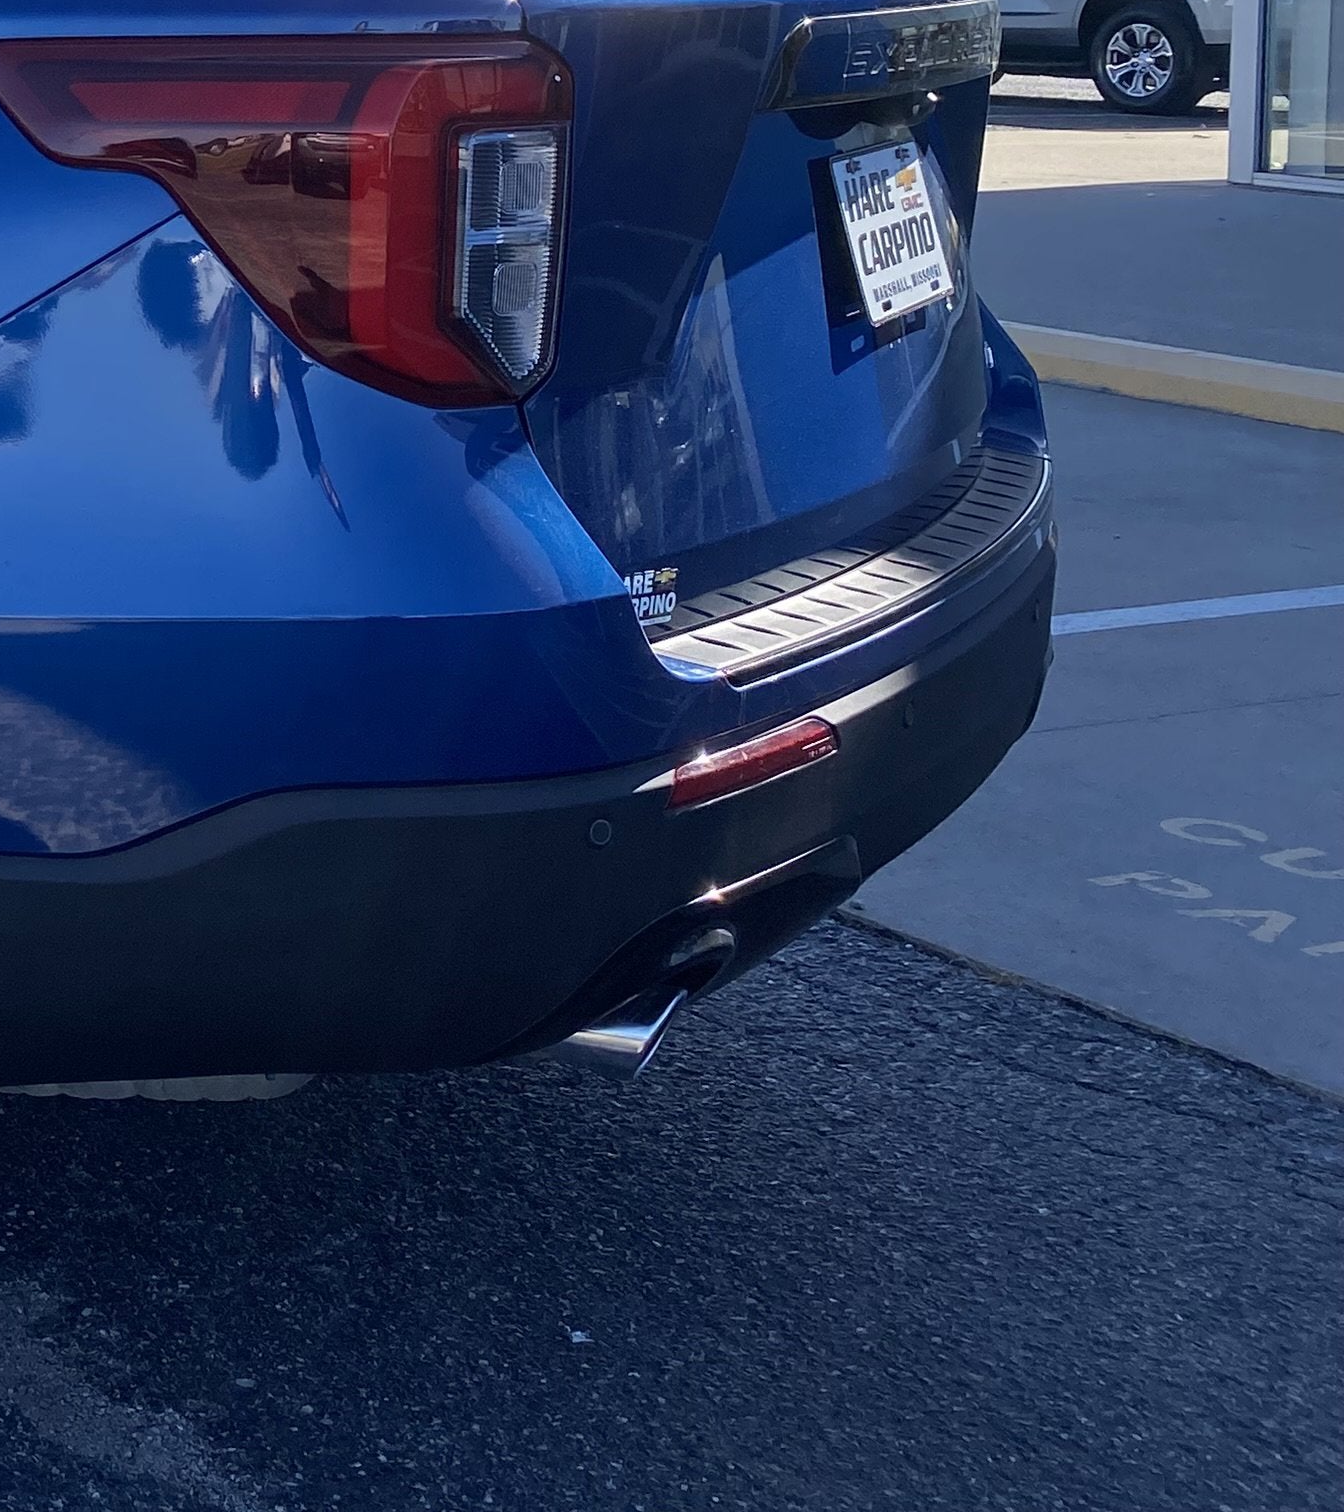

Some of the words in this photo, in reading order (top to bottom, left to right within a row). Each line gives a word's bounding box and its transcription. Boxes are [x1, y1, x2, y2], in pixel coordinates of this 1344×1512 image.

[844, 168, 895, 223] HARE
[900, 192, 924, 212] GMC
[858, 211, 936, 276] CARPINO
[623, 569, 655, 595] ARE
[631, 591, 677, 617] RPINO
[1086, 870, 1344, 958] PA
